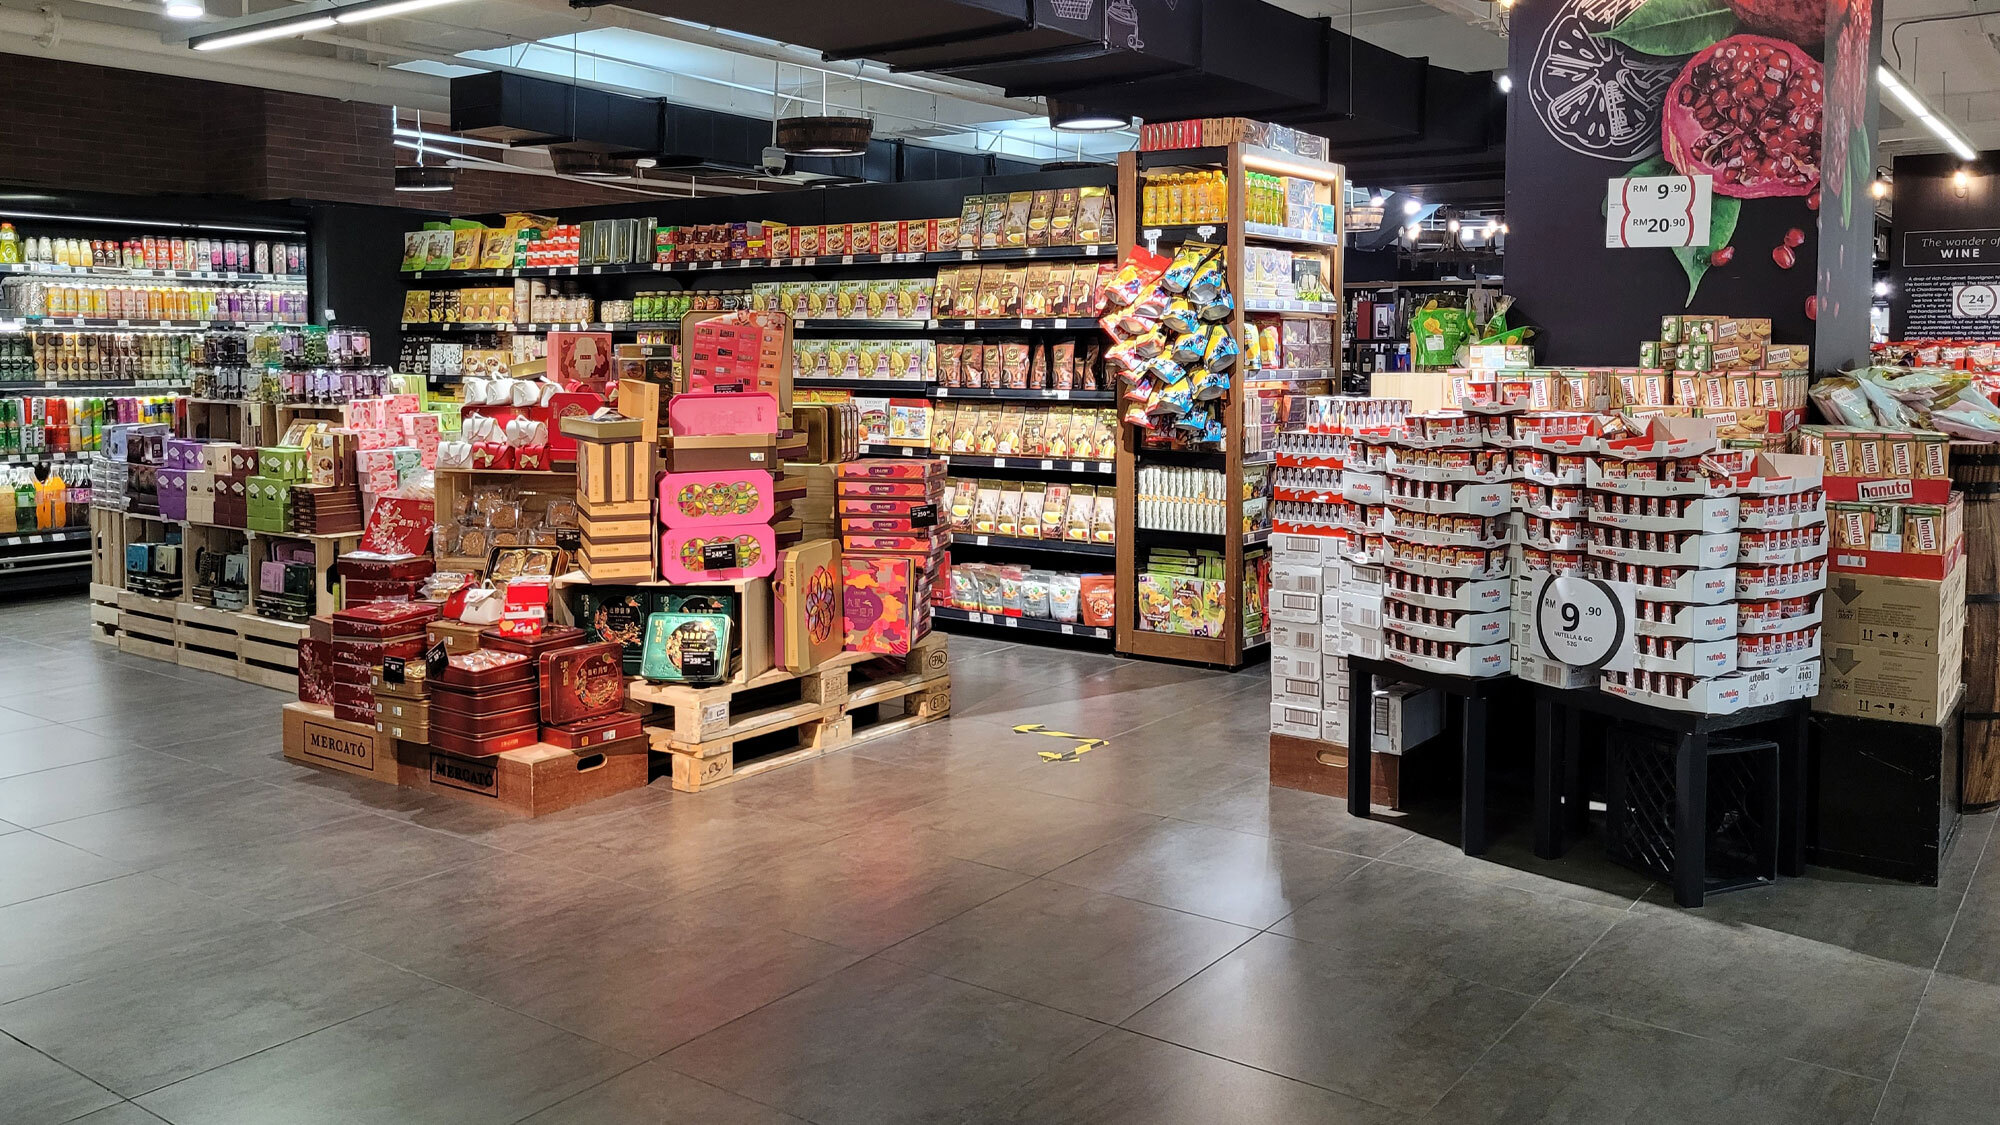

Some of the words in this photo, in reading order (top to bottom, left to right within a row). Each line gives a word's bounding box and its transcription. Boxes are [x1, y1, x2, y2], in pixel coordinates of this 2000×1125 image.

[1633, 184, 1648, 193] RM
[1632, 218, 1648, 226] RM
[1921, 237, 1942, 247] The
[1946, 236, 1987, 247] wonder
[1940, 248, 1980, 258] WINE
[1968, 294, 1985, 304] 24
[1715, 348, 1739, 362] hanuta
[1768, 350, 1790, 361] hanuta
[1572, 381, 1582, 406] hanuta
[1623, 377, 1633, 404] hanuta
[1648, 378, 1659, 405] hanuta
[1682, 380, 1694, 406] hanuta
[1710, 380, 1721, 405] hanuta
[1737, 381, 1748, 407] hanuta
[1765, 381, 1775, 408] hanuta
[1834, 443, 1846, 472] hanuta
[1865, 443, 1876, 472] hanuta
[1896, 445, 1908, 474] hanuta
[1930, 445, 1941, 474] hanuta
[1353, 483, 1371, 491] nutella
[1596, 481, 1618, 489] nutella
[1861, 481, 1910, 498] hanuta
[1850, 515, 1861, 544] hanuta
[1920, 519, 1932, 549] hanuta
[1709, 544, 1728, 553] nutella
[1705, 579, 1725, 589] nutella
[1481, 589, 1501, 598] nutella
[1545, 598, 1556, 609] RM
[1389, 622, 1406, 630] nutella
[1481, 622, 1500, 631] nutella
[1705, 616, 1726, 626] nutella
[1554, 631, 1577, 641] NUTELLA
[1390, 653, 1407, 661] nutella
[1482, 653, 1501, 663] nutella
[1706, 651, 1727, 661] nutella
[1797, 671, 1812, 680] 4103
[1608, 686, 1628, 694] nutella
[1718, 690, 1739, 699] nutella
[310, 733, 366, 758] MERCATÓ
[435, 761, 494, 787] MERCATÓ
